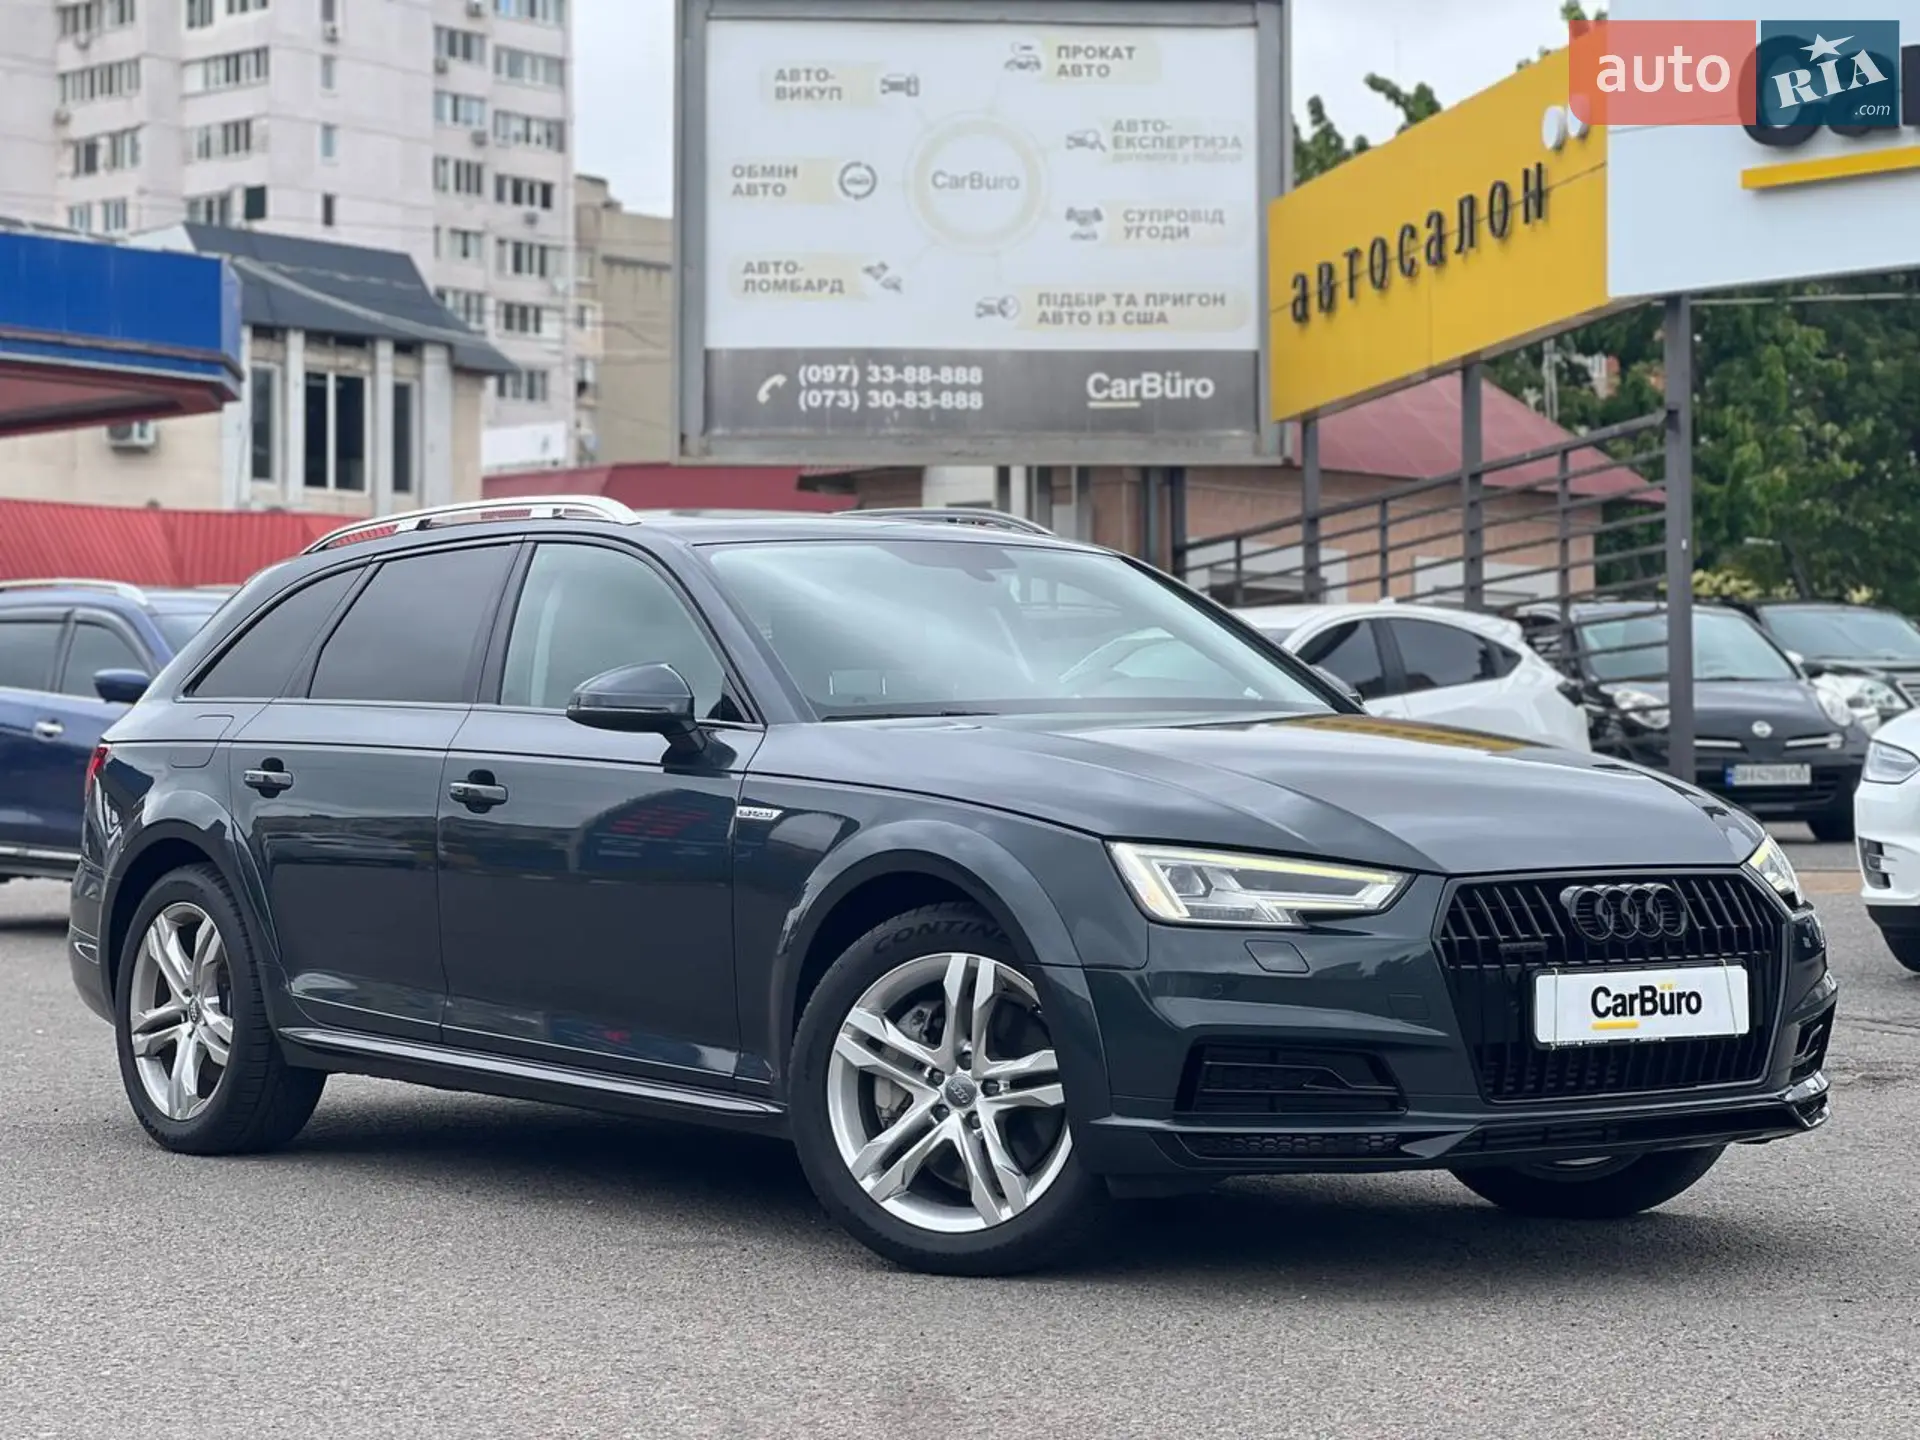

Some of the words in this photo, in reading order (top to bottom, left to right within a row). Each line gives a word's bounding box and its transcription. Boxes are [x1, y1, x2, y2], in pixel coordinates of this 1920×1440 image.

[1056, 45, 1136, 60] ПРОКАТ
[774, 68, 836, 82] АВТО-
[1056, 63, 1111, 78] АВТО
[775, 86, 842, 101] ВИКУП
[1112, 119, 1172, 133] АВТО-
[1112, 135, 1243, 150] ЕКСПЕРТИЗА
[731, 164, 798, 179] ОБМІН
[731, 182, 787, 197] АВТО
[1122, 208, 1226, 225] СУПРОВІД
[1123, 225, 1191, 241] УГОДИ
[1291, 161, 1545, 324] автосалон
[743, 261, 805, 275] АВТО-
[743, 278, 845, 294] ЛОМБАРД
[1037, 292, 1106, 309] ПІДБІР
[1111, 292, 1138, 308] ТА
[1144, 292, 1227, 308] ПРИГОН
[1037, 310, 1092, 326] АВТО
[1122, 310, 1169, 326] США
[798, 364, 860, 387] (097)
[866, 364, 984, 386] 33-88-888
[1086, 371, 1215, 400] CarBüro
[798, 389, 860, 412] (073)
[866, 389, 984, 410] 30-83-888
[1590, 983, 1704, 1019] CarBüro
